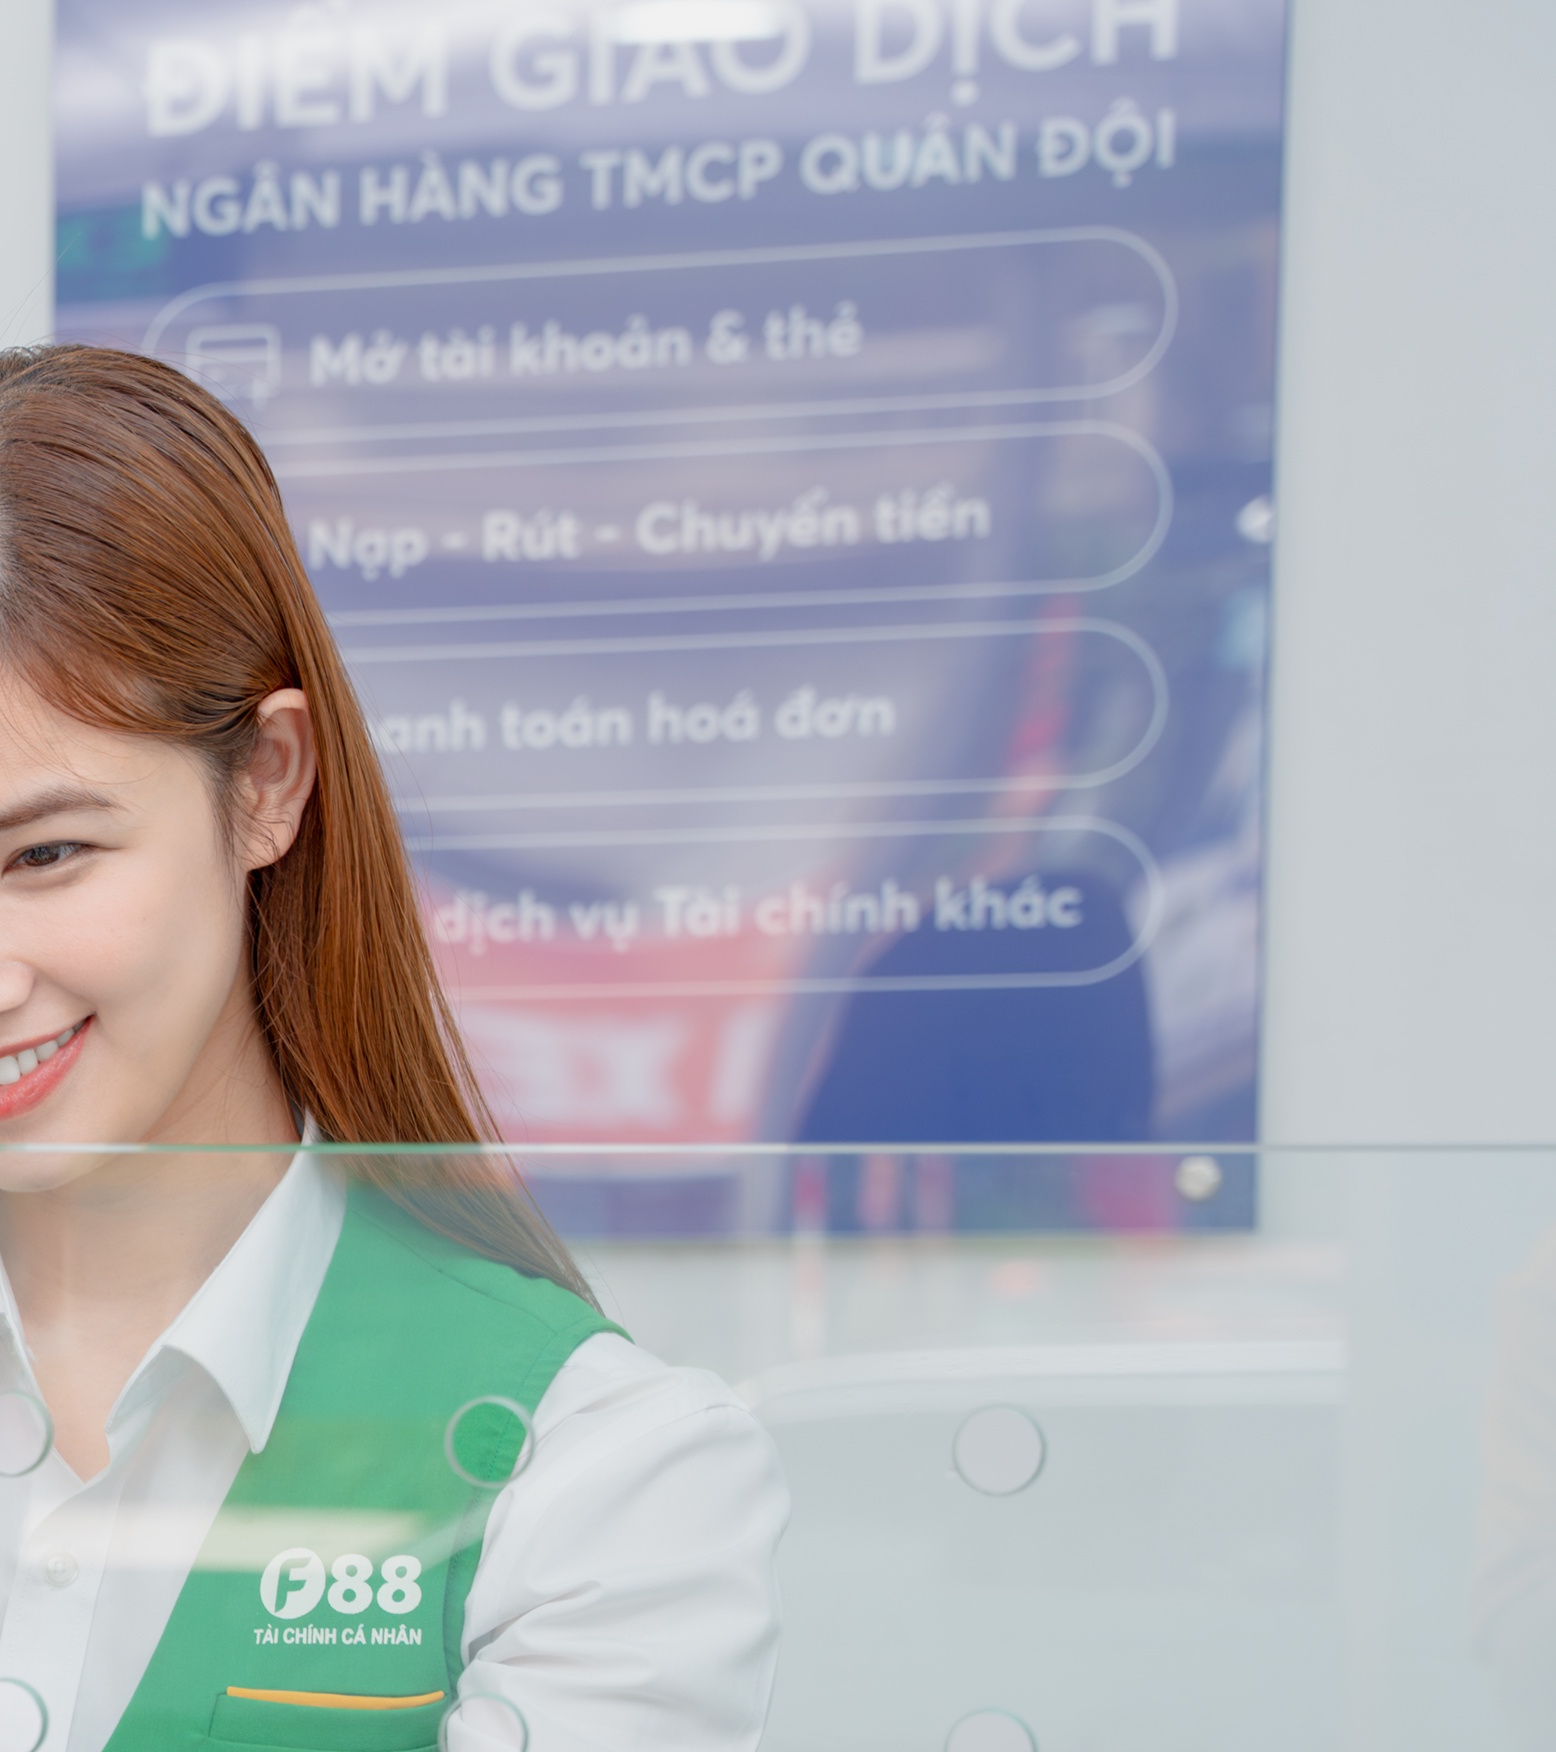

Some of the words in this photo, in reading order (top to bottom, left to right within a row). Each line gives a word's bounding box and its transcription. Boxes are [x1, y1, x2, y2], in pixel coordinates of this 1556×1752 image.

[490, 8, 813, 110] GIAO
[140, 160, 342, 240] NGÂN
[360, 150, 564, 226] HÀNG
[578, 138, 784, 210] TMCP
[1036, 98, 1176, 188] ĐỘI
[309, 328, 407, 386] Mở
[416, 326, 494, 382] tài
[508, 312, 692, 376] khoản
[706, 308, 756, 364] &
[764, 300, 864, 360] thẻ
[309, 517, 429, 580] Nạp
[485, 506, 584, 562] Rút
[634, 486, 858, 560] Chuyển
[874, 482, 992, 544] tiền
[380, 700, 487, 754] anh
[500, 694, 632, 750] toán
[646, 690, 758, 744] hoá
[774, 684, 896, 740] đơn
[434, 890, 556, 956] dịch
[568, 900, 639, 952] vụ
[652, 886, 742, 938] Tài
[754, 876, 922, 936] chính
[933, 874, 1084, 930] khác
[259, 1547, 422, 1619] F88
[254, 1624, 278, 1645] TÀI
[283, 1624, 337, 1645] CHÍNH
[341, 1624, 366, 1645] CÁ
[371, 1624, 422, 1646] NHÂN
